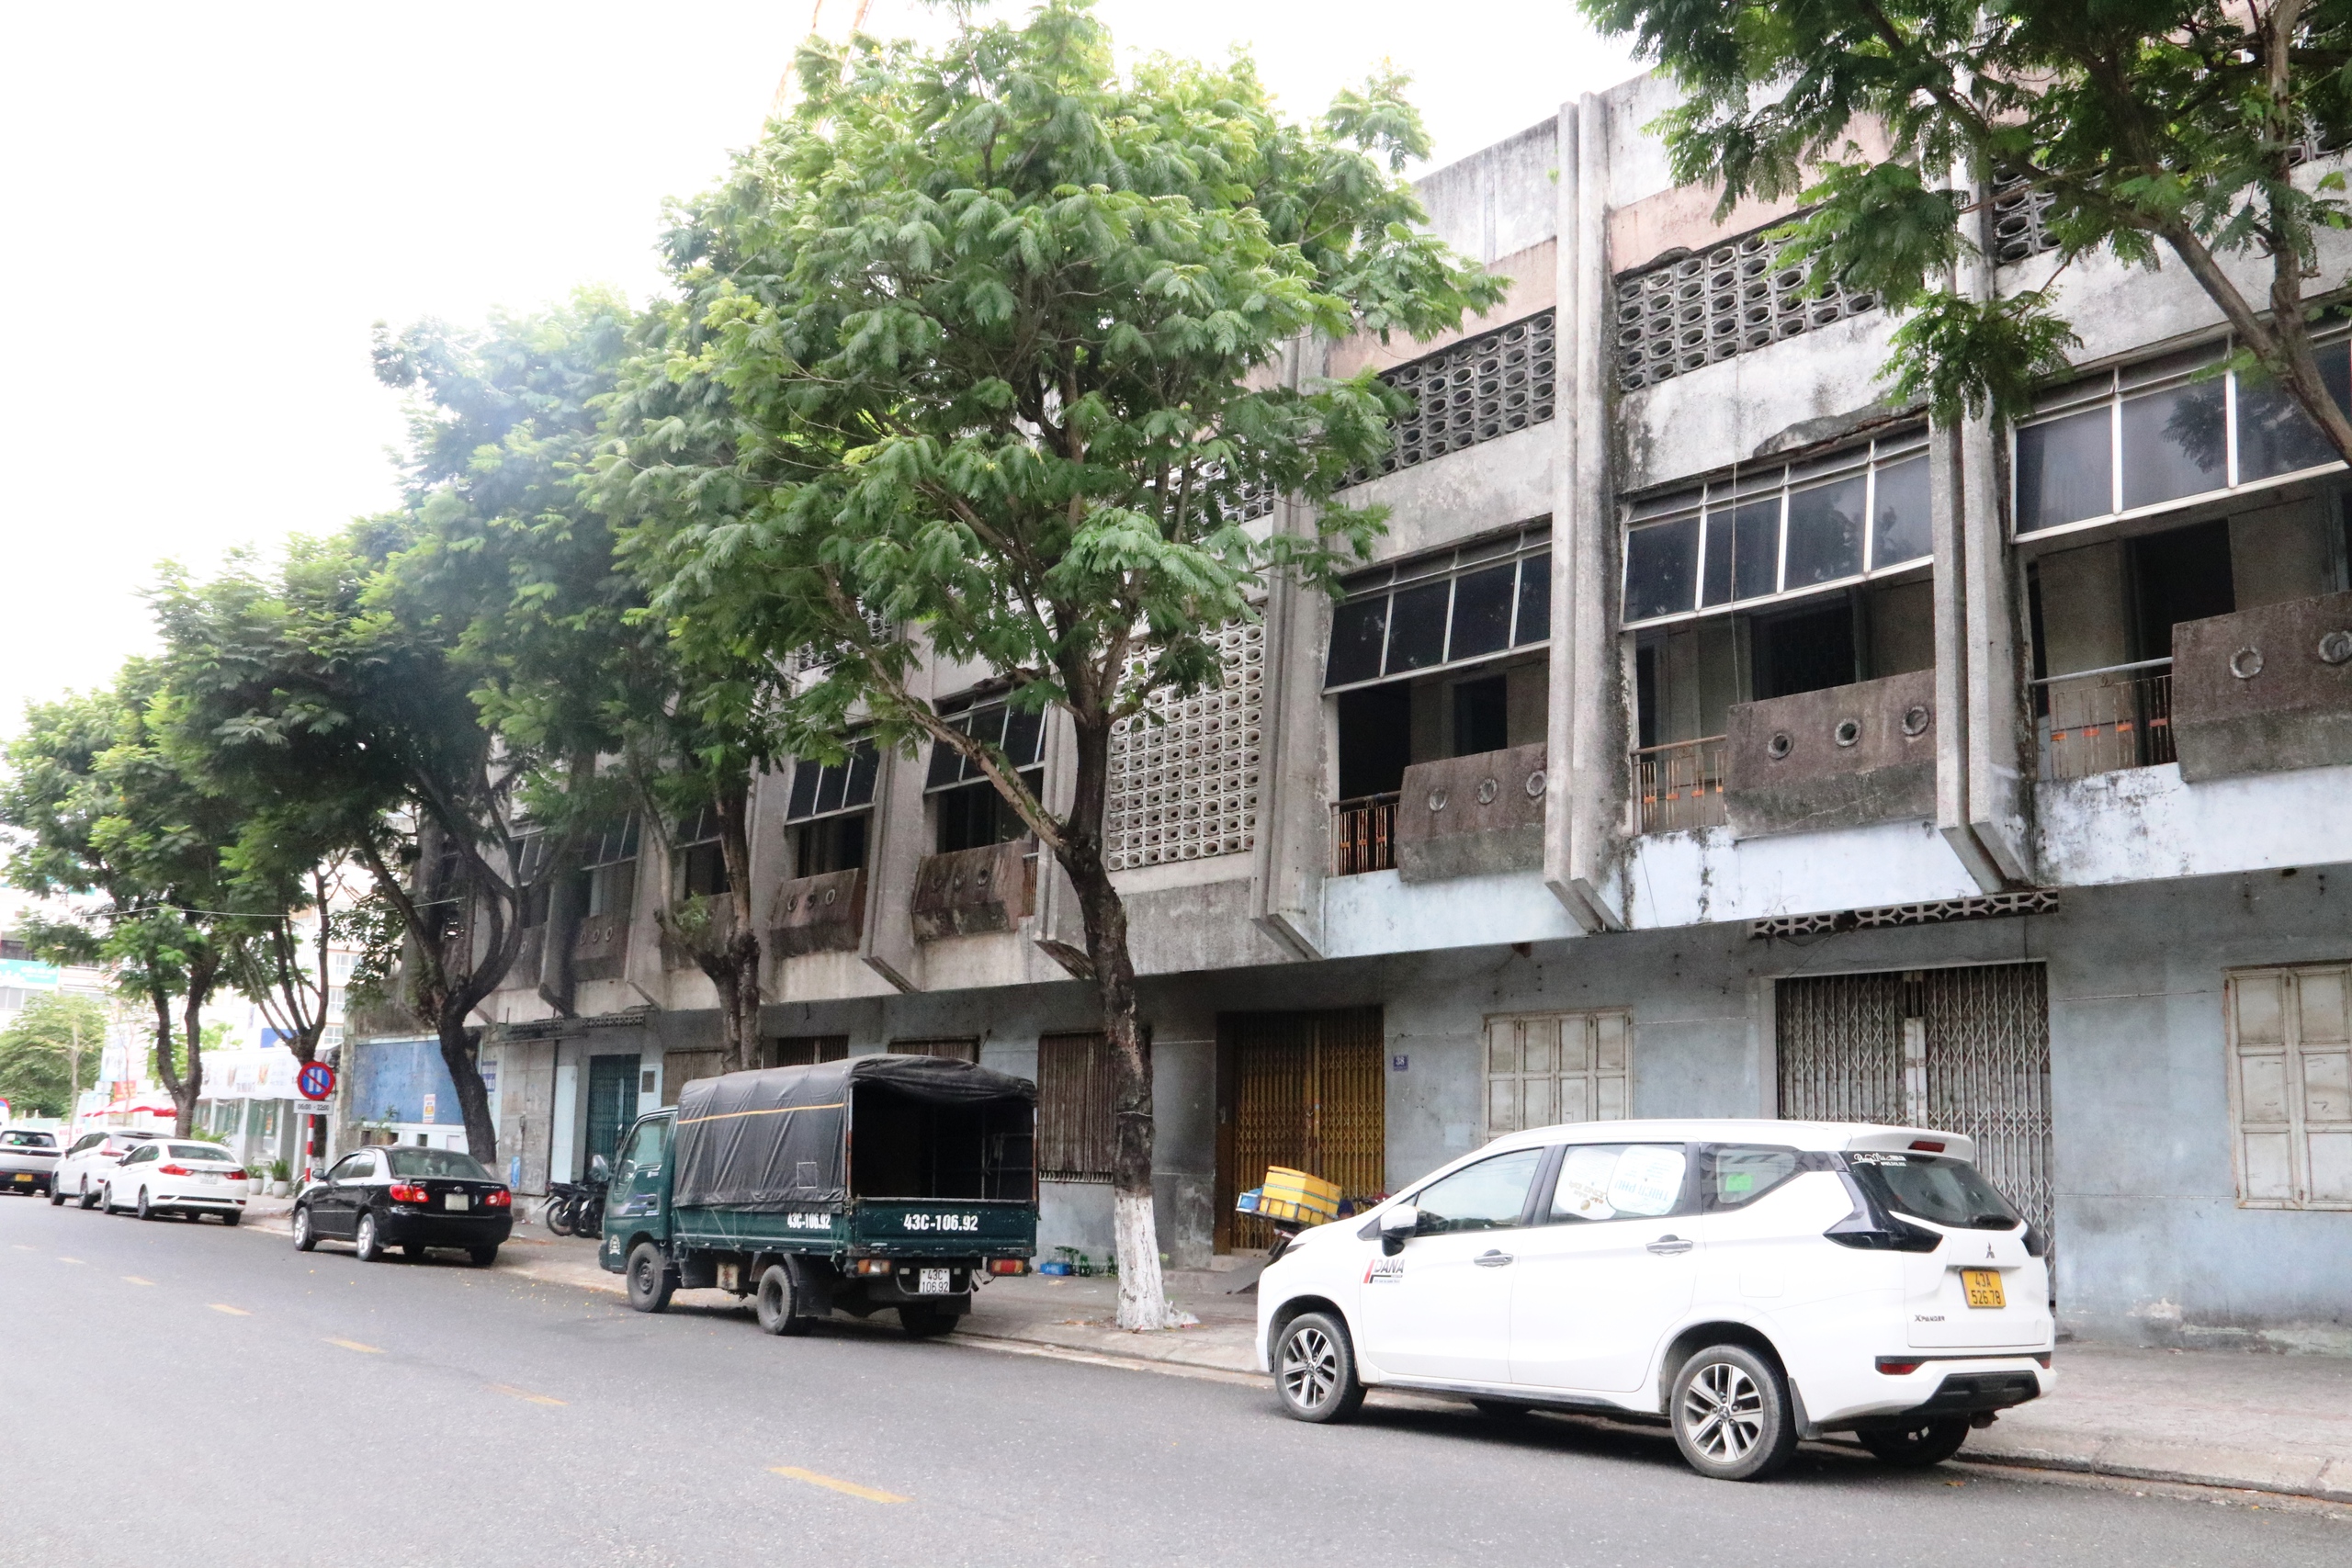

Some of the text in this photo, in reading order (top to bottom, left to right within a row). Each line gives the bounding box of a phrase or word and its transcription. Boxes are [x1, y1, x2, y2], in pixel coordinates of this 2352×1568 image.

[787, 1212, 831, 1229] 43C-106.92
[903, 1213, 978, 1231] 43C-106.92
[927, 1269, 944, 1280] 43C
[1975, 1272, 1992, 1288] 43A
